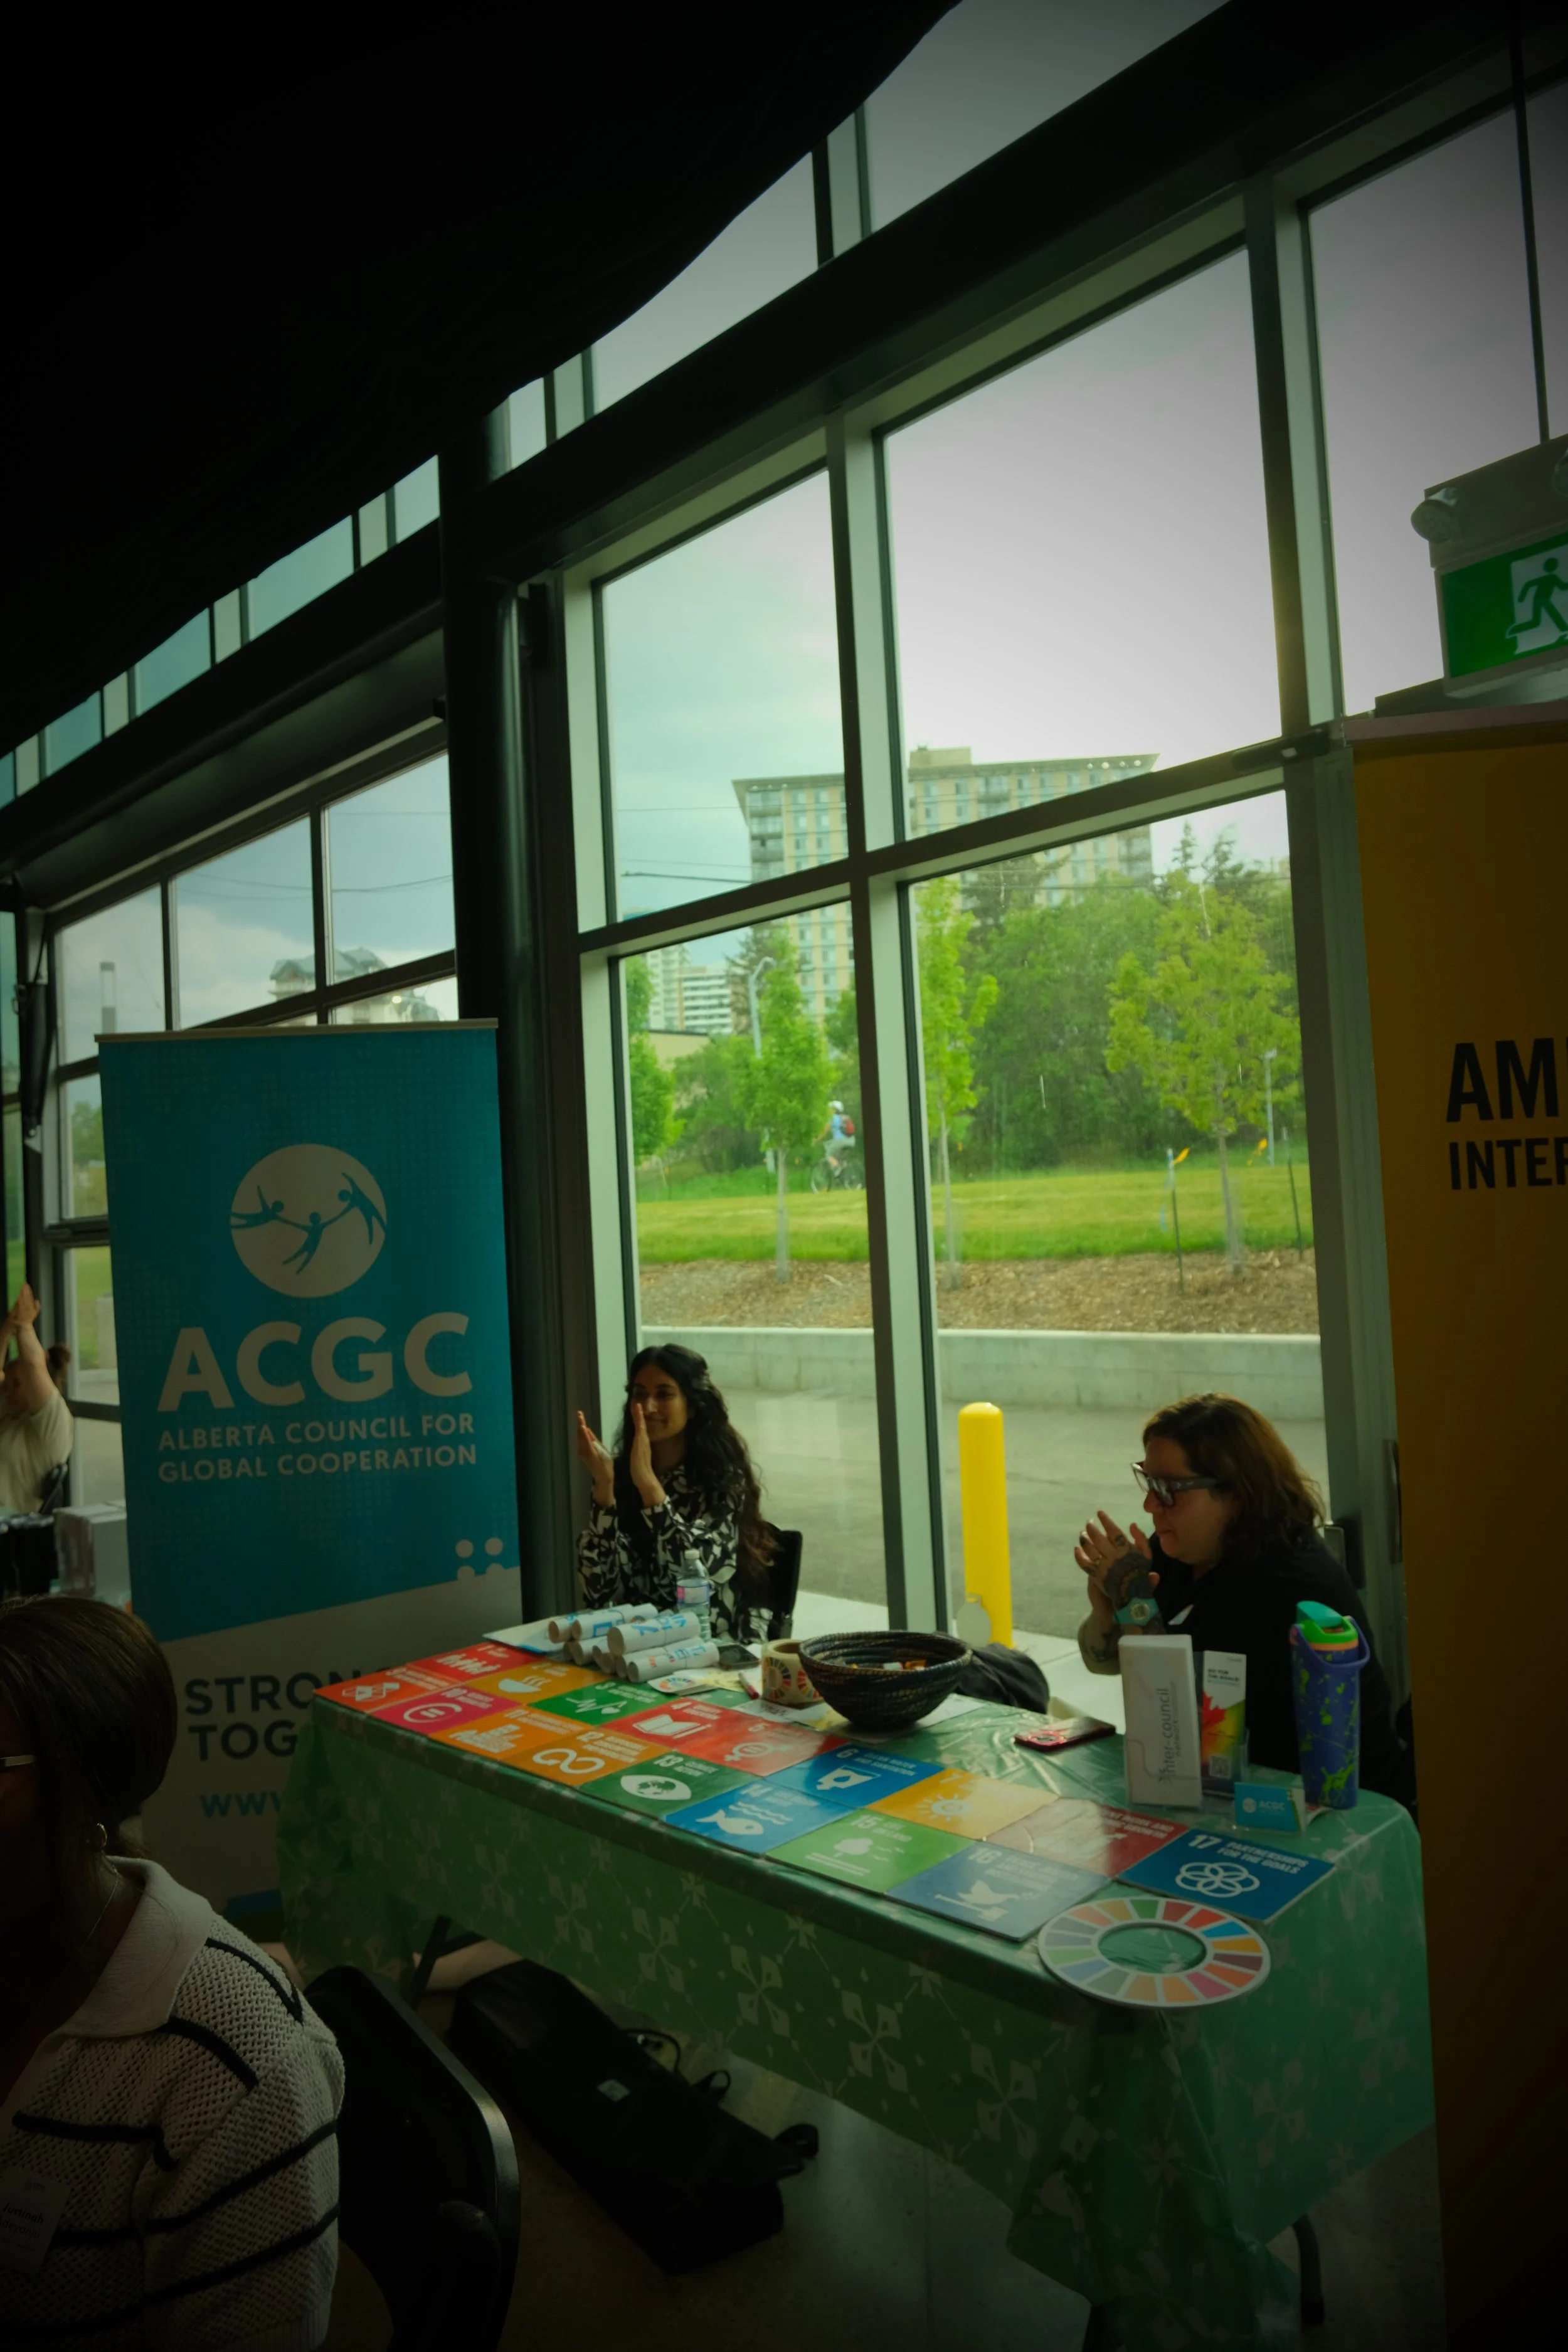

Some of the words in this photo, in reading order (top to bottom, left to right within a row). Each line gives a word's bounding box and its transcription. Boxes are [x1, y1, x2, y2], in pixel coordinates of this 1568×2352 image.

[1446, 1036, 1568, 1123] AM
[157, 1311, 474, 1413] ACGC
[158, 1423, 276, 1451] ALBERTA
[285, 1416, 411, 1445] COUNCIL
[421, 1412, 475, 1436] FOR
[158, 1453, 268, 1484] GLOBAL
[277, 1445, 478, 1476] COOPERATION
[185, 1666, 380, 1715] STRO
[188, 1720, 297, 1762] TOG
[967, 1847, 1003, 1864] 16
[1188, 1834, 1222, 1850] 17
[1216, 1846, 1242, 1858] FOR
[1240, 1852, 1263, 1865] THE
[1261, 1858, 1301, 1875] GOALS
